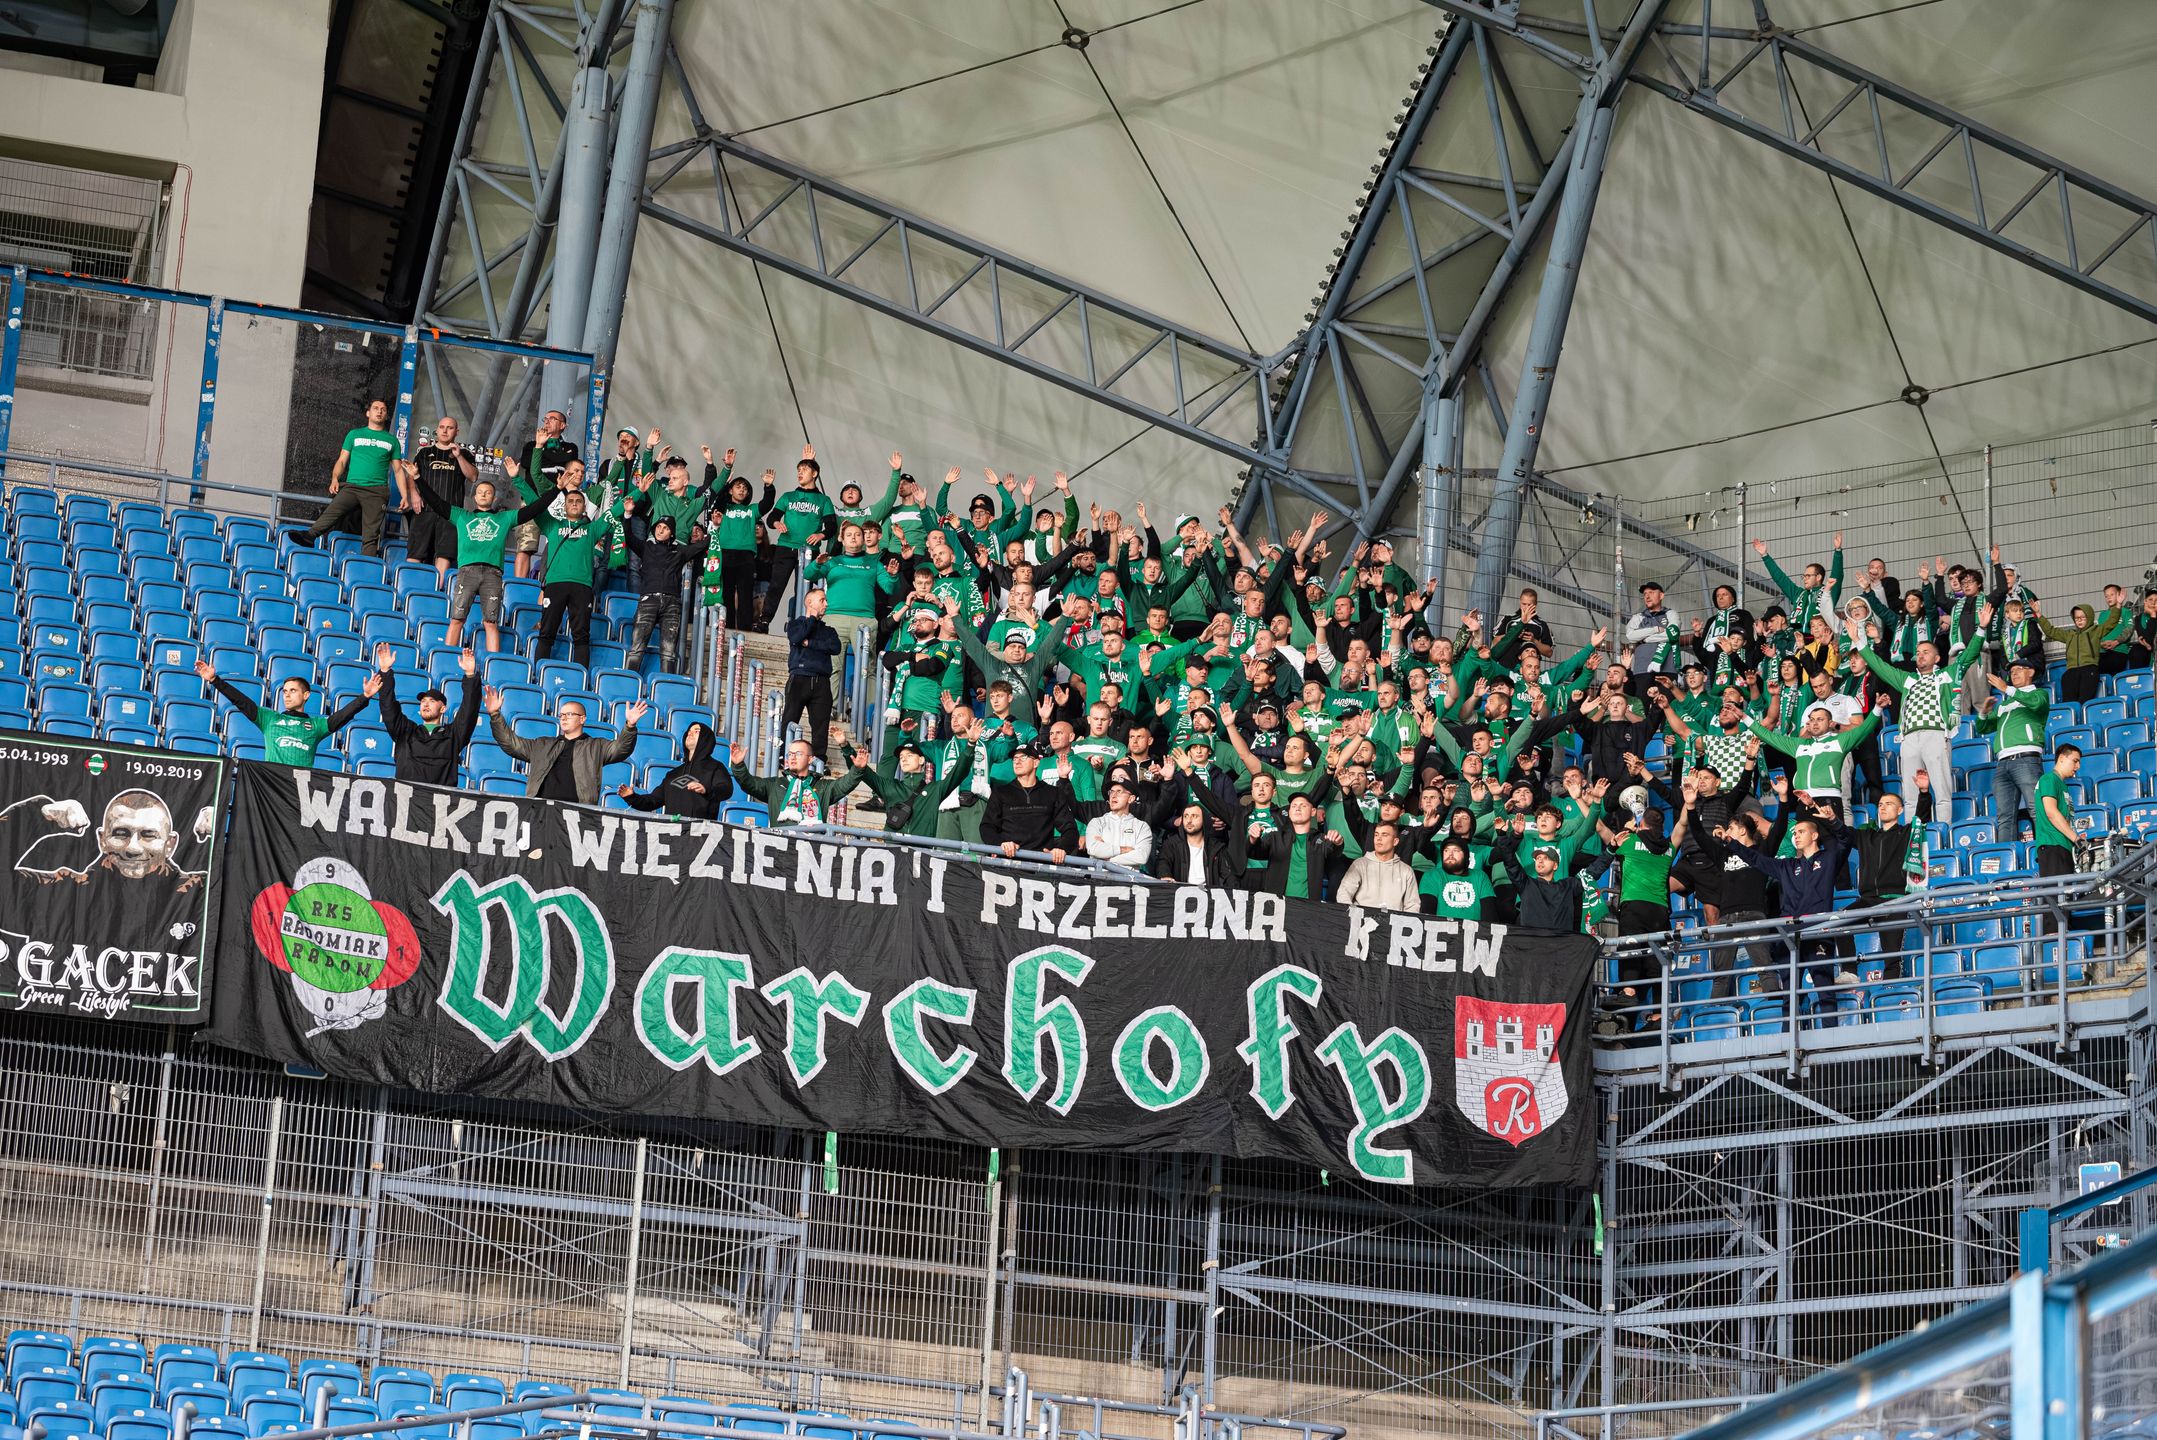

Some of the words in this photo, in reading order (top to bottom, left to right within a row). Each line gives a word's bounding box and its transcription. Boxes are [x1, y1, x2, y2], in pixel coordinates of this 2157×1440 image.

[788, 501, 820, 515] RADOMIAK
[1099, 671, 1130, 683] RAOMIAK
[279, 737, 310, 751] Enea
[125, 761, 203, 781] 19.09.2019
[325, 863, 336, 879] 9
[311, 900, 353, 922] RKS
[979, 870, 1287, 943] PRZELANA
[1344, 906, 1508, 978] KREW
[282, 915, 381, 957] RADOMIAK
[17, 940, 199, 996] GACEK
[291, 942, 372, 979] RADOM
[15, 985, 65, 1011] Green
[69, 990, 131, 1020] Lifestyle
[1491, 1083, 1535, 1135] R
